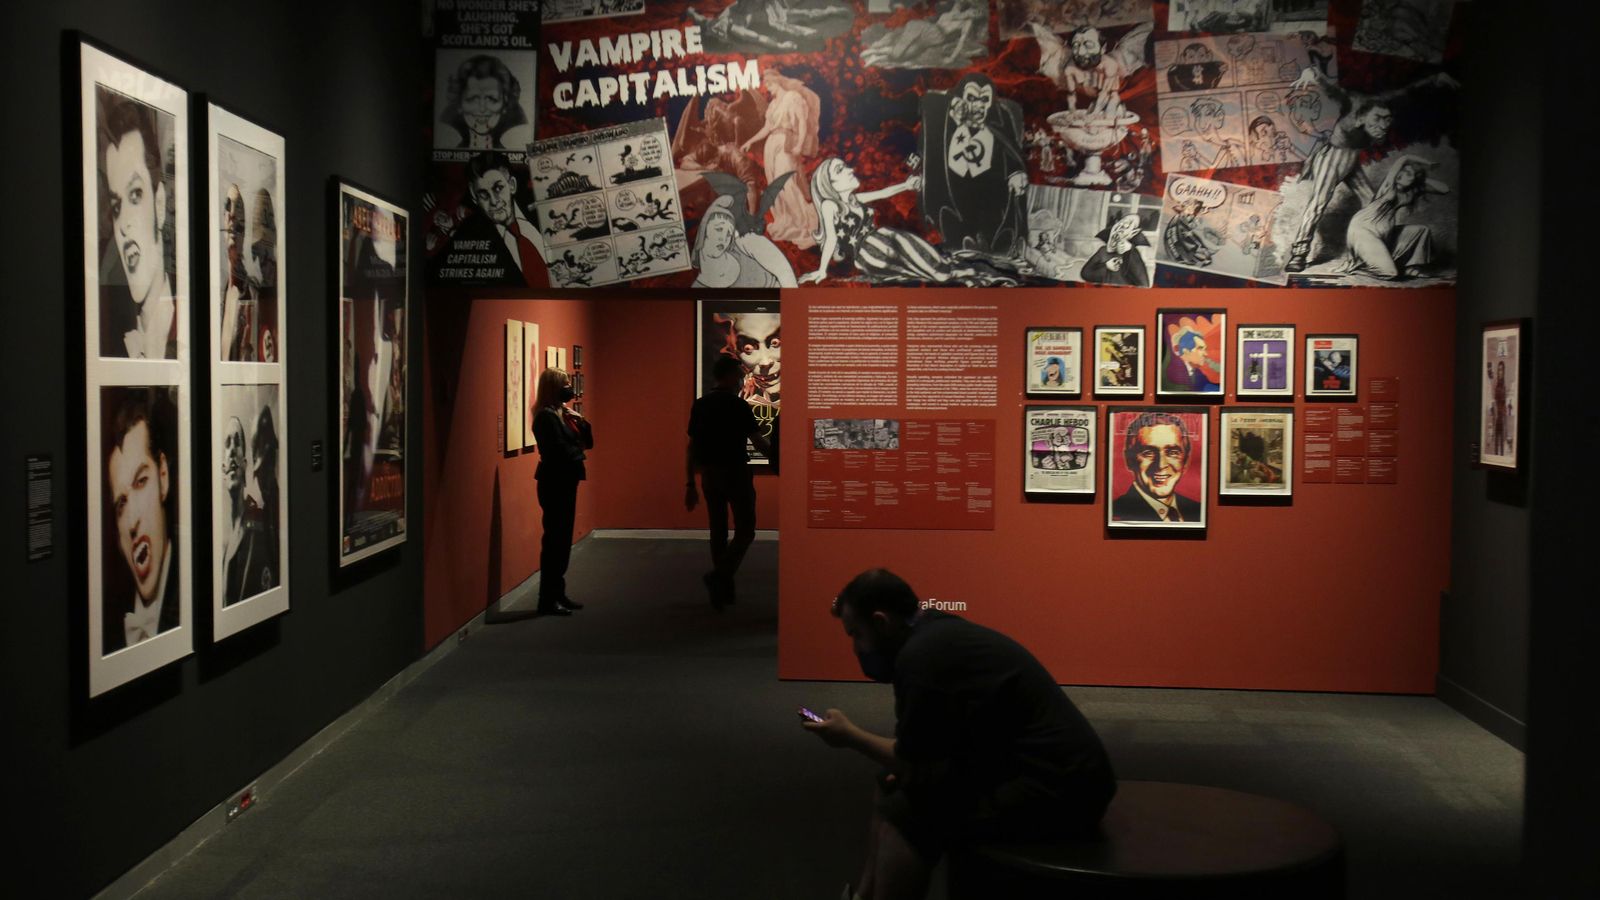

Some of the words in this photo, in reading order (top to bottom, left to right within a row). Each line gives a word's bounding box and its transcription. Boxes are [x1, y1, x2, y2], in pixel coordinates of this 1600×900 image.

[457, 11, 520, 23] LAUGHING.
[460, 23, 490, 34] SHE'S
[492, 23, 514, 34] GOT
[442, 34, 509, 46] SCOTLAND'S
[511, 35, 533, 47] OIL.
[548, 25, 704, 73] VAMPIRE
[552, 60, 761, 110] CAPITALISM
[432, 151, 452, 161] STOP
[508, 152, 524, 161] SNP
[453, 240, 491, 250] VAMPIRE
[447, 254, 497, 264] CAPITALISM
[439, 268, 476, 279] STRIKES
[476, 268, 504, 279] AGAIN!
[1031, 418, 1062, 426] CHARLIE
[1064, 418, 1089, 426] HEBDO
